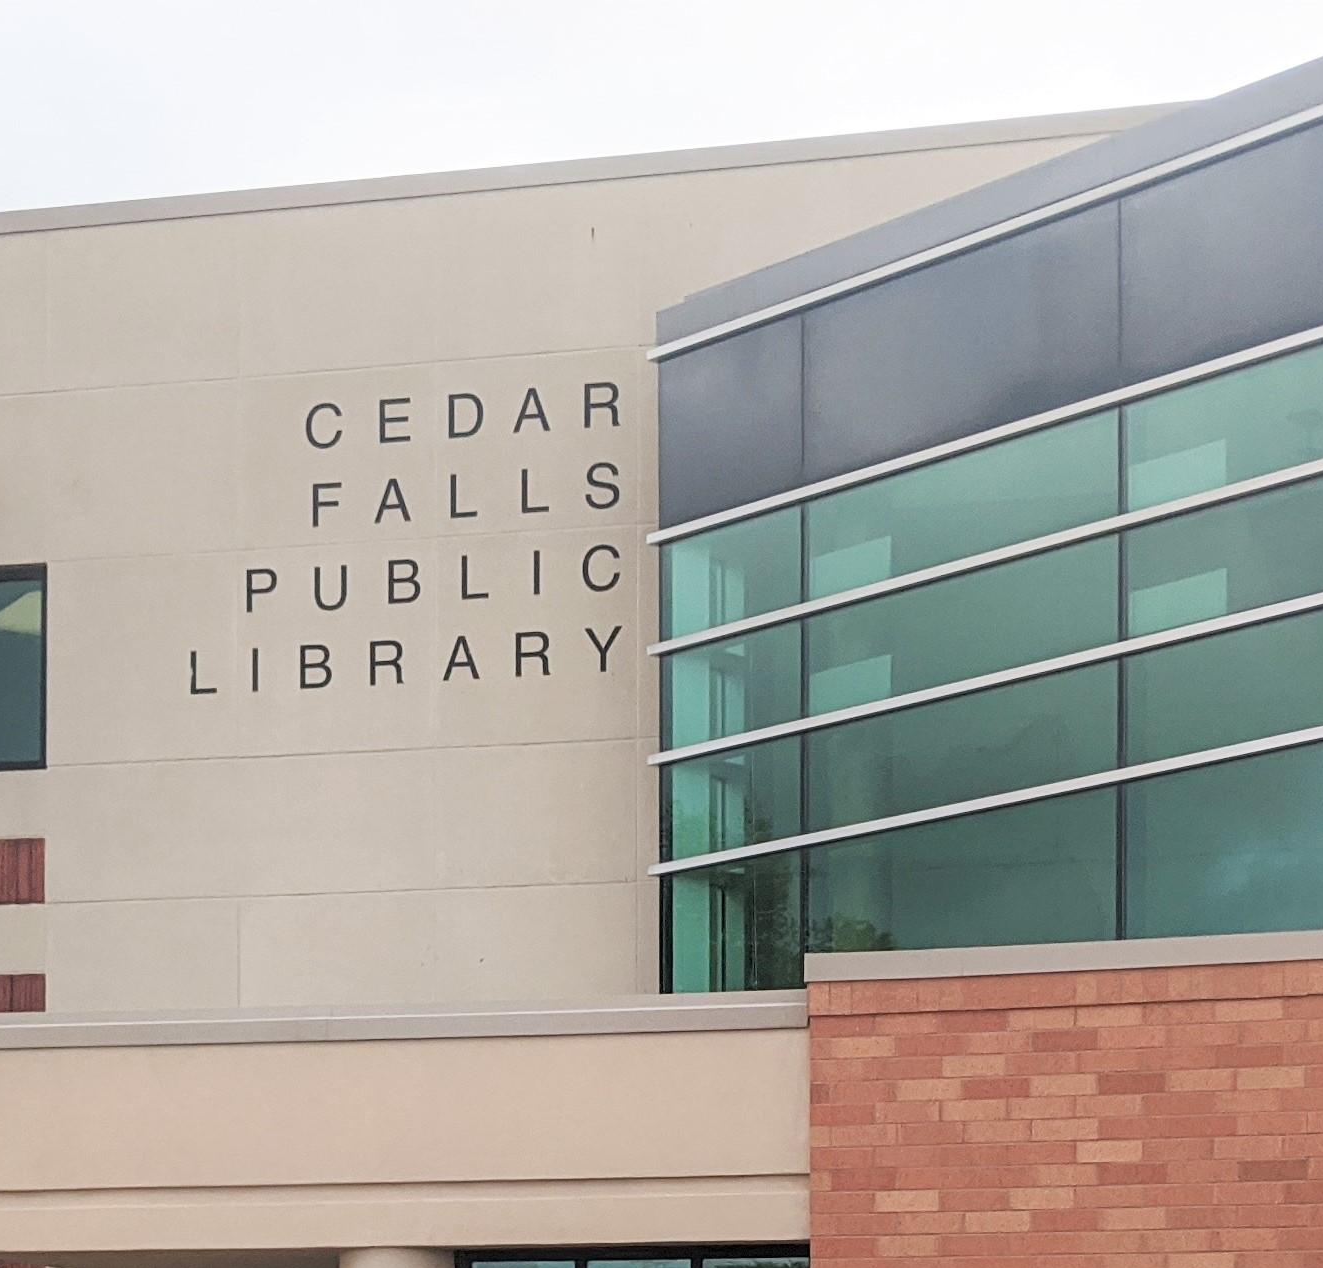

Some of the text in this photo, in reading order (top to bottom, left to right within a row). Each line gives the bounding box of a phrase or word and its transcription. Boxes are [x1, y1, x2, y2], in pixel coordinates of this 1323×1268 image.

[305, 381, 620, 449] CEDAR
[312, 461, 620, 528] FALLS
[245, 543, 621, 613] PUBLIC
[189, 625, 622, 695] LIBRARY
